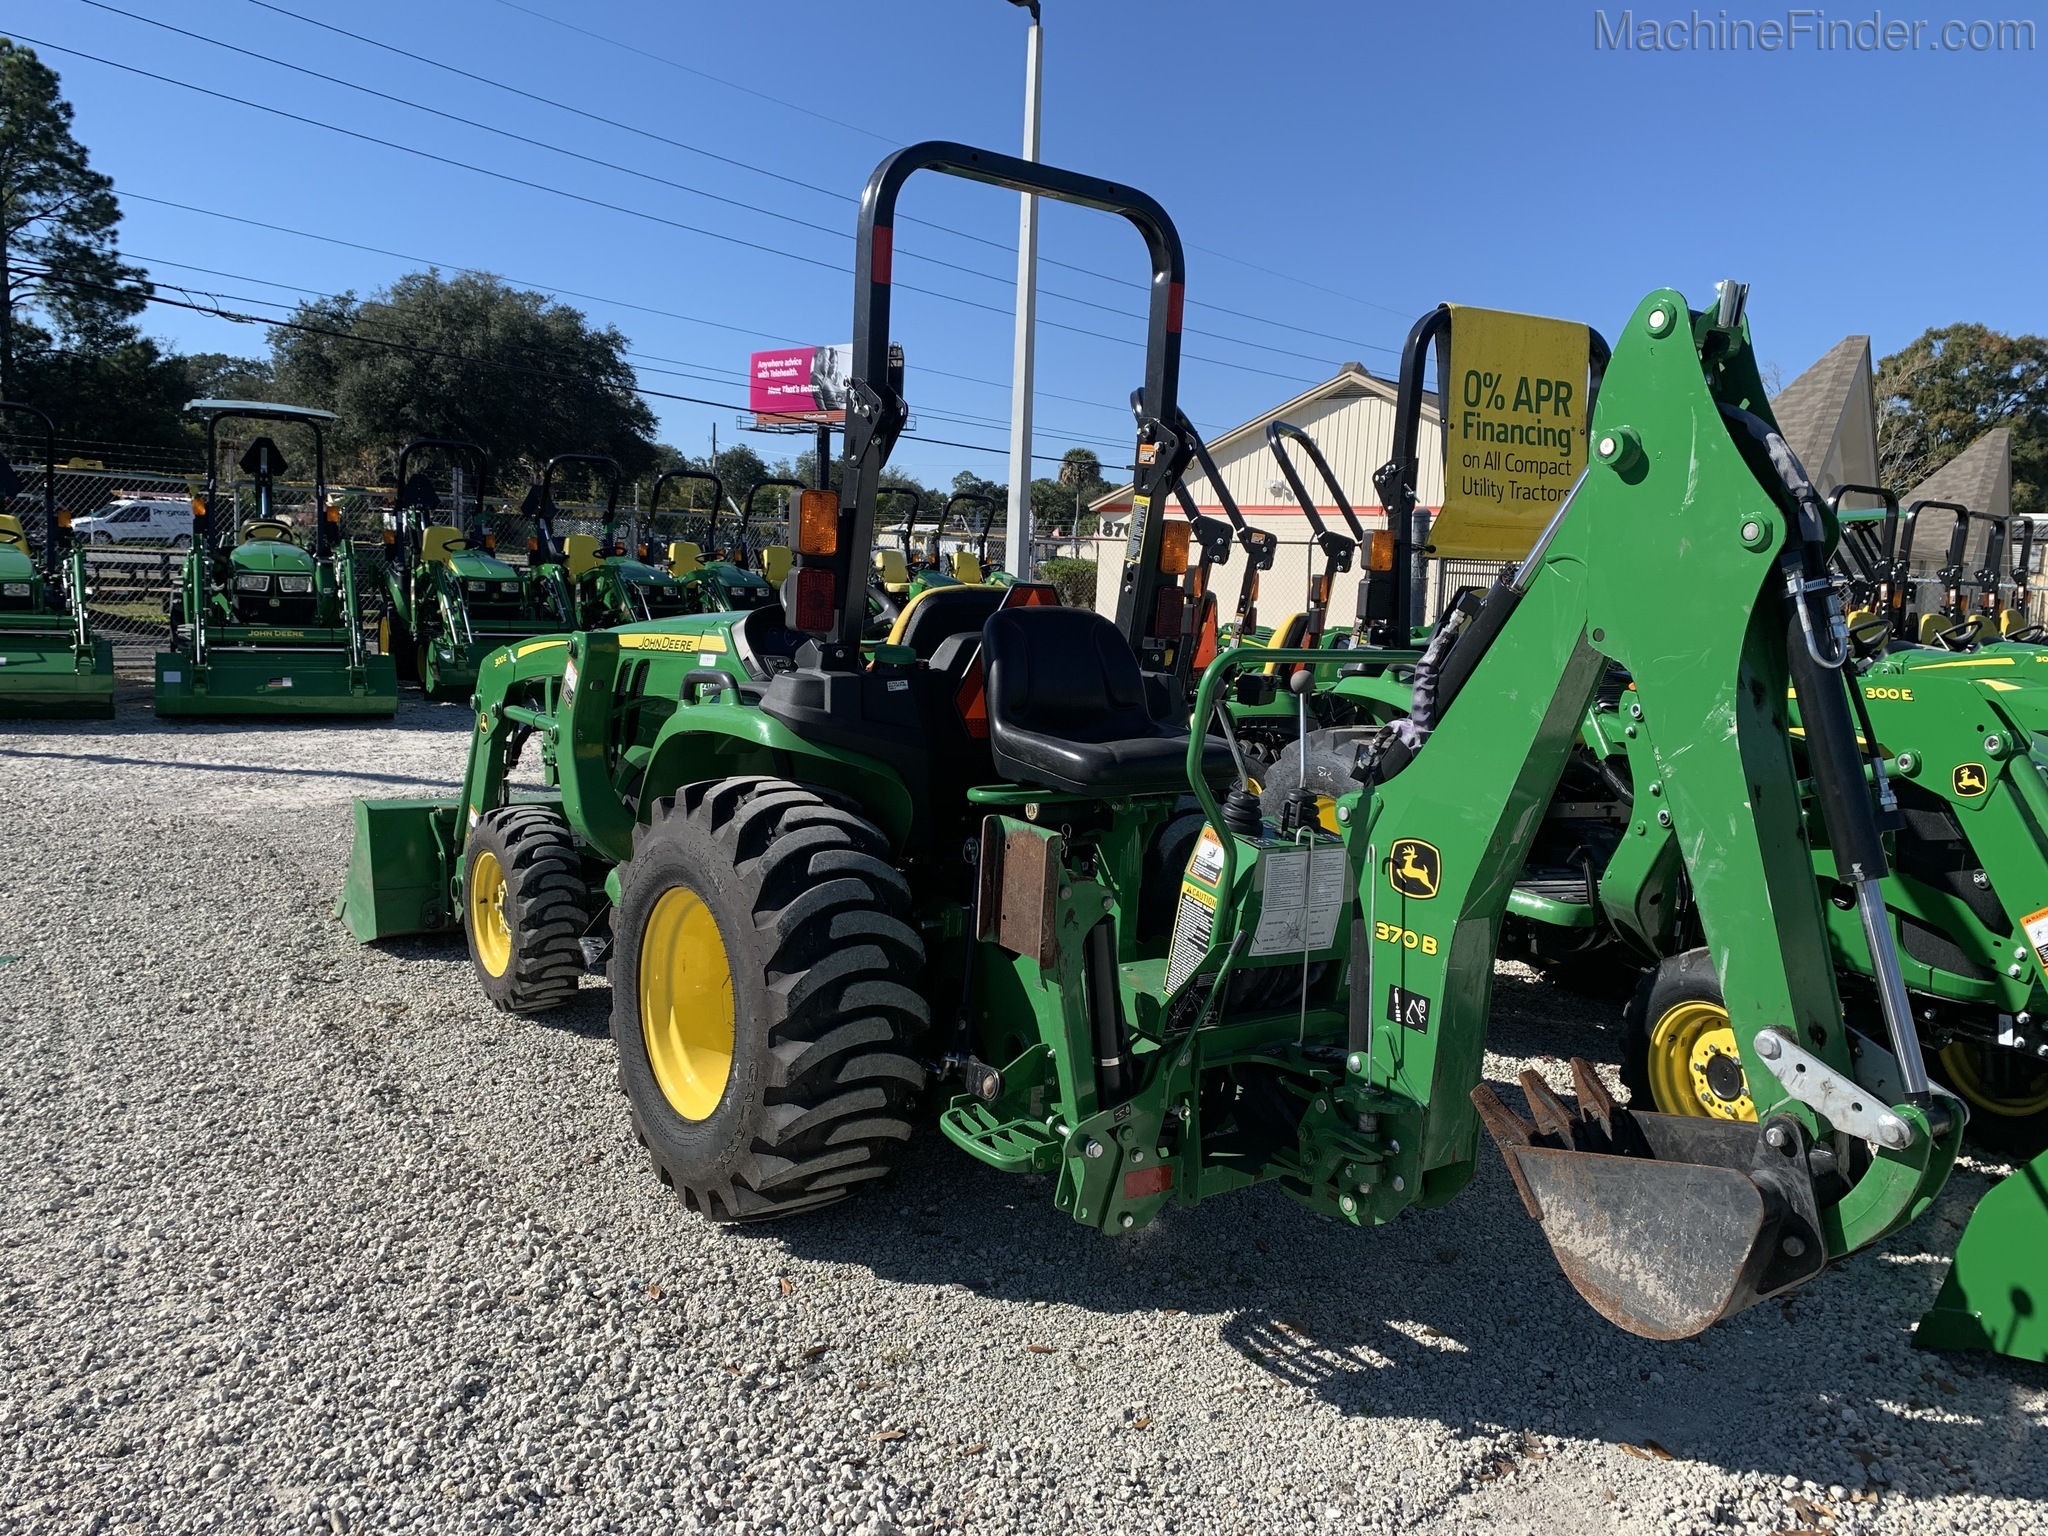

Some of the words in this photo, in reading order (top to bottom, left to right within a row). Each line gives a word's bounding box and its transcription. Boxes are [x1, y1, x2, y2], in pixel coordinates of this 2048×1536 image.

[758, 359, 784, 369] Anywhere
[785, 357, 803, 366] advice
[757, 370, 769, 378] with
[1464, 369, 1505, 411] 0%
[1512, 376, 1573, 418] APR
[1463, 454, 1480, 469] on
[1484, 451, 1501, 471] All
[1505, 453, 1572, 480] Compact
[1462, 476, 1505, 504] Utility
[639, 636, 662, 648] JOHN
[661, 637, 693, 650] DEERE
[1192, 887, 1217, 907] CAUTION
